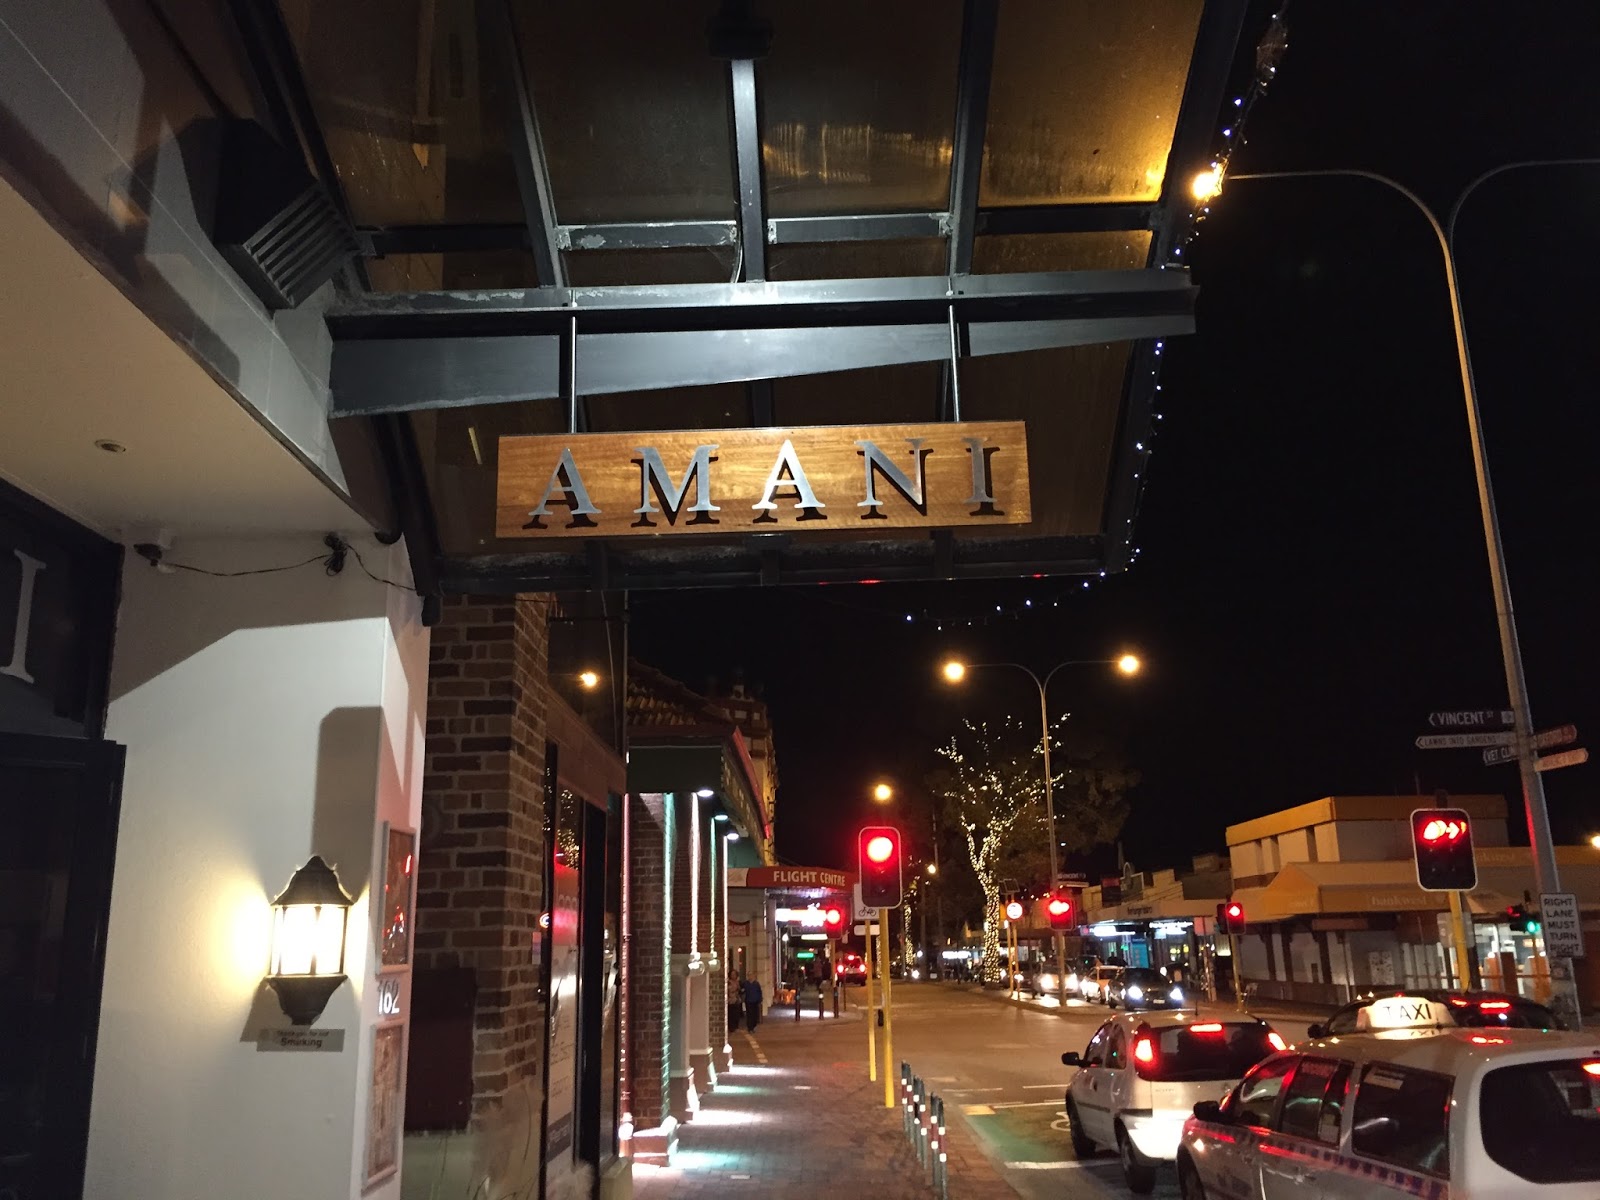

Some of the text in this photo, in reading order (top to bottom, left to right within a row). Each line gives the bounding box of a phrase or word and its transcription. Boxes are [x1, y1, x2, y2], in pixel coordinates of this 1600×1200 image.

[527, 438, 999, 515] AMANI
[1437, 711, 1484, 726] VINCENT
[773, 870, 846, 887] FLIGHT CENTRE
[1544, 898, 1573, 906] RIGHT
[1546, 910, 1574, 918] LANE
[1548, 921, 1575, 929] MUST
[1550, 932, 1578, 940] TURN
[1550, 943, 1580, 952] RIGHT
[377, 981, 401, 1015] 162
[1383, 1003, 1432, 1020] TAXI
[281, 1037, 323, 1049] Smoking
